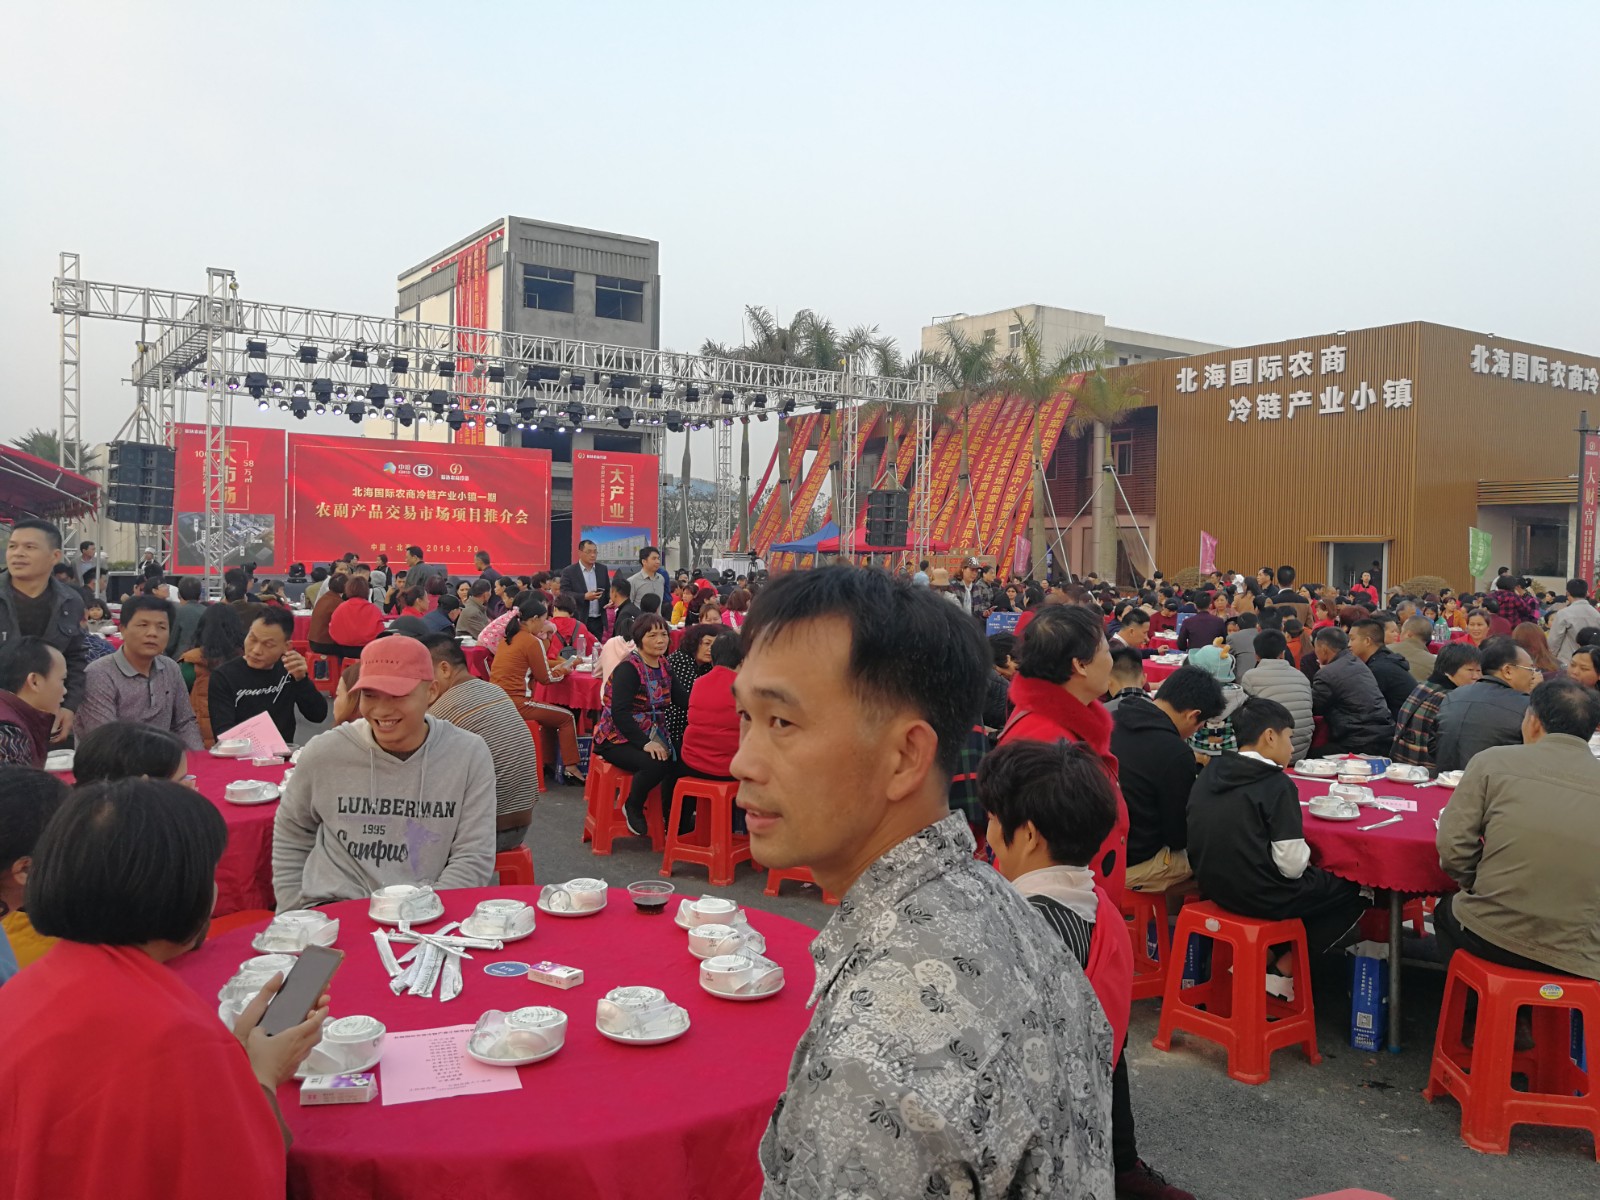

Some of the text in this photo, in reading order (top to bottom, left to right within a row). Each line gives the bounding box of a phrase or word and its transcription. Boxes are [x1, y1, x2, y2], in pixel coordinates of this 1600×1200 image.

[1176, 345, 1347, 393] 北海国际农商
[1470, 344, 1599, 395] 北海国际农商冷
[1228, 378, 1413, 423] 冷链产业小镇
[315, 501, 529, 524] 农副产品交易市场项目推介会
[352, 486, 497, 502] 北海国际农商冷链产业小镇一期
[609, 468, 625, 518] 大产业
[1585, 467, 1596, 526] 大财富
[426, 544, 479, 553] 2019.1.20
[338, 796, 456, 818] LUMBERMAN
